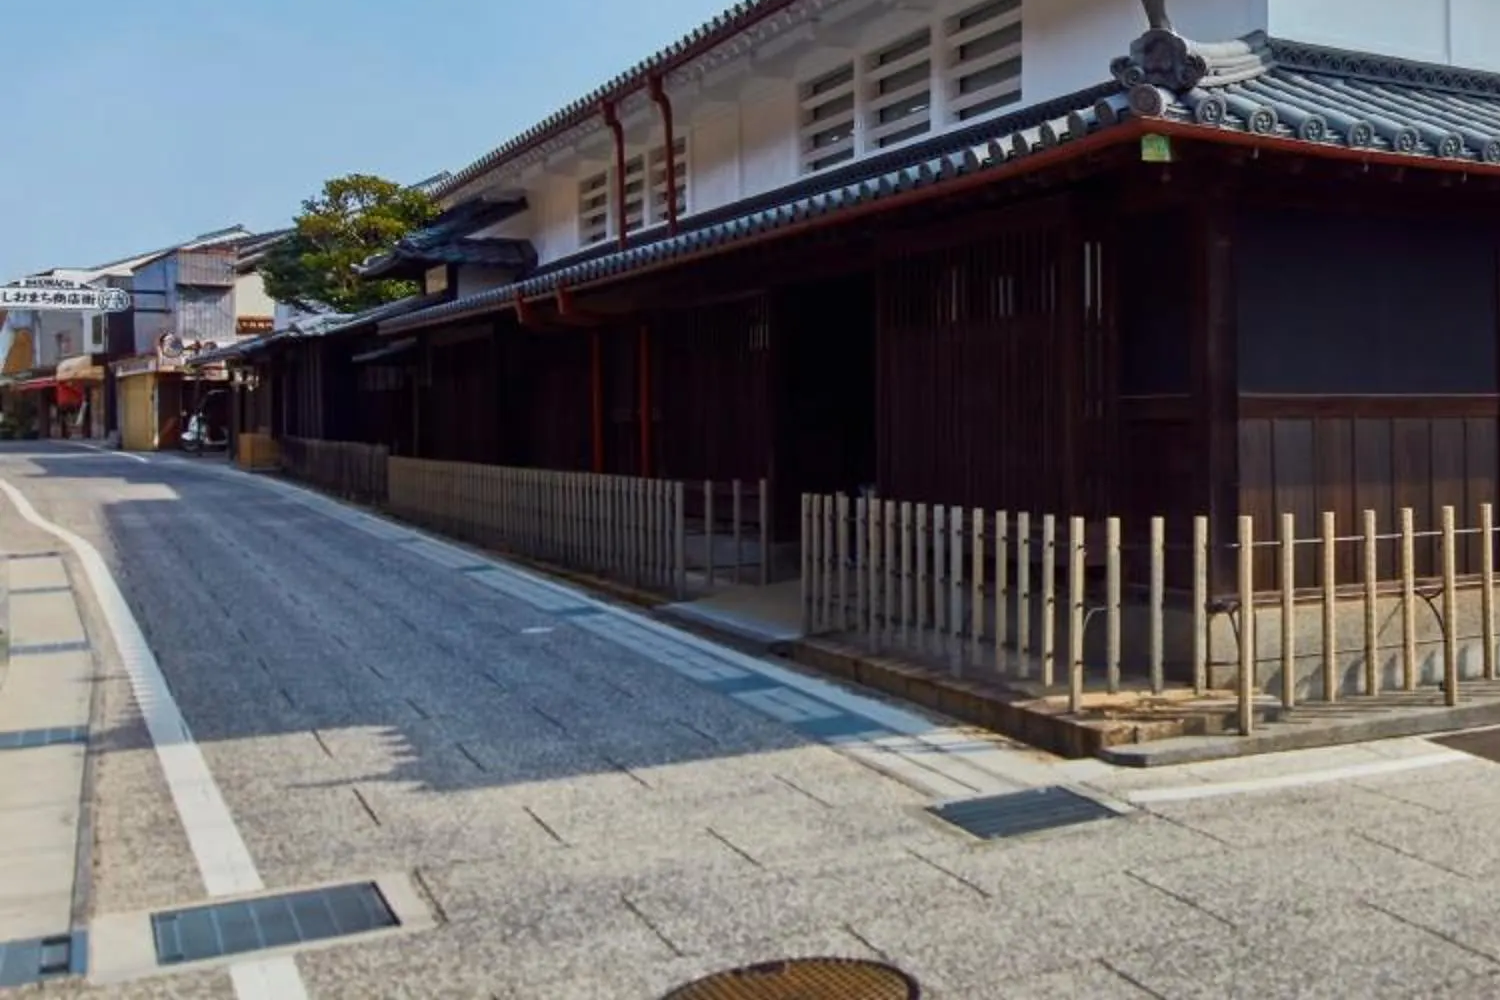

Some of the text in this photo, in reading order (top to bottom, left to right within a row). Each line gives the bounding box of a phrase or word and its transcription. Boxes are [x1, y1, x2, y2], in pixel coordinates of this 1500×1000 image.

[3, 291, 96, 305] しおまち商店街
